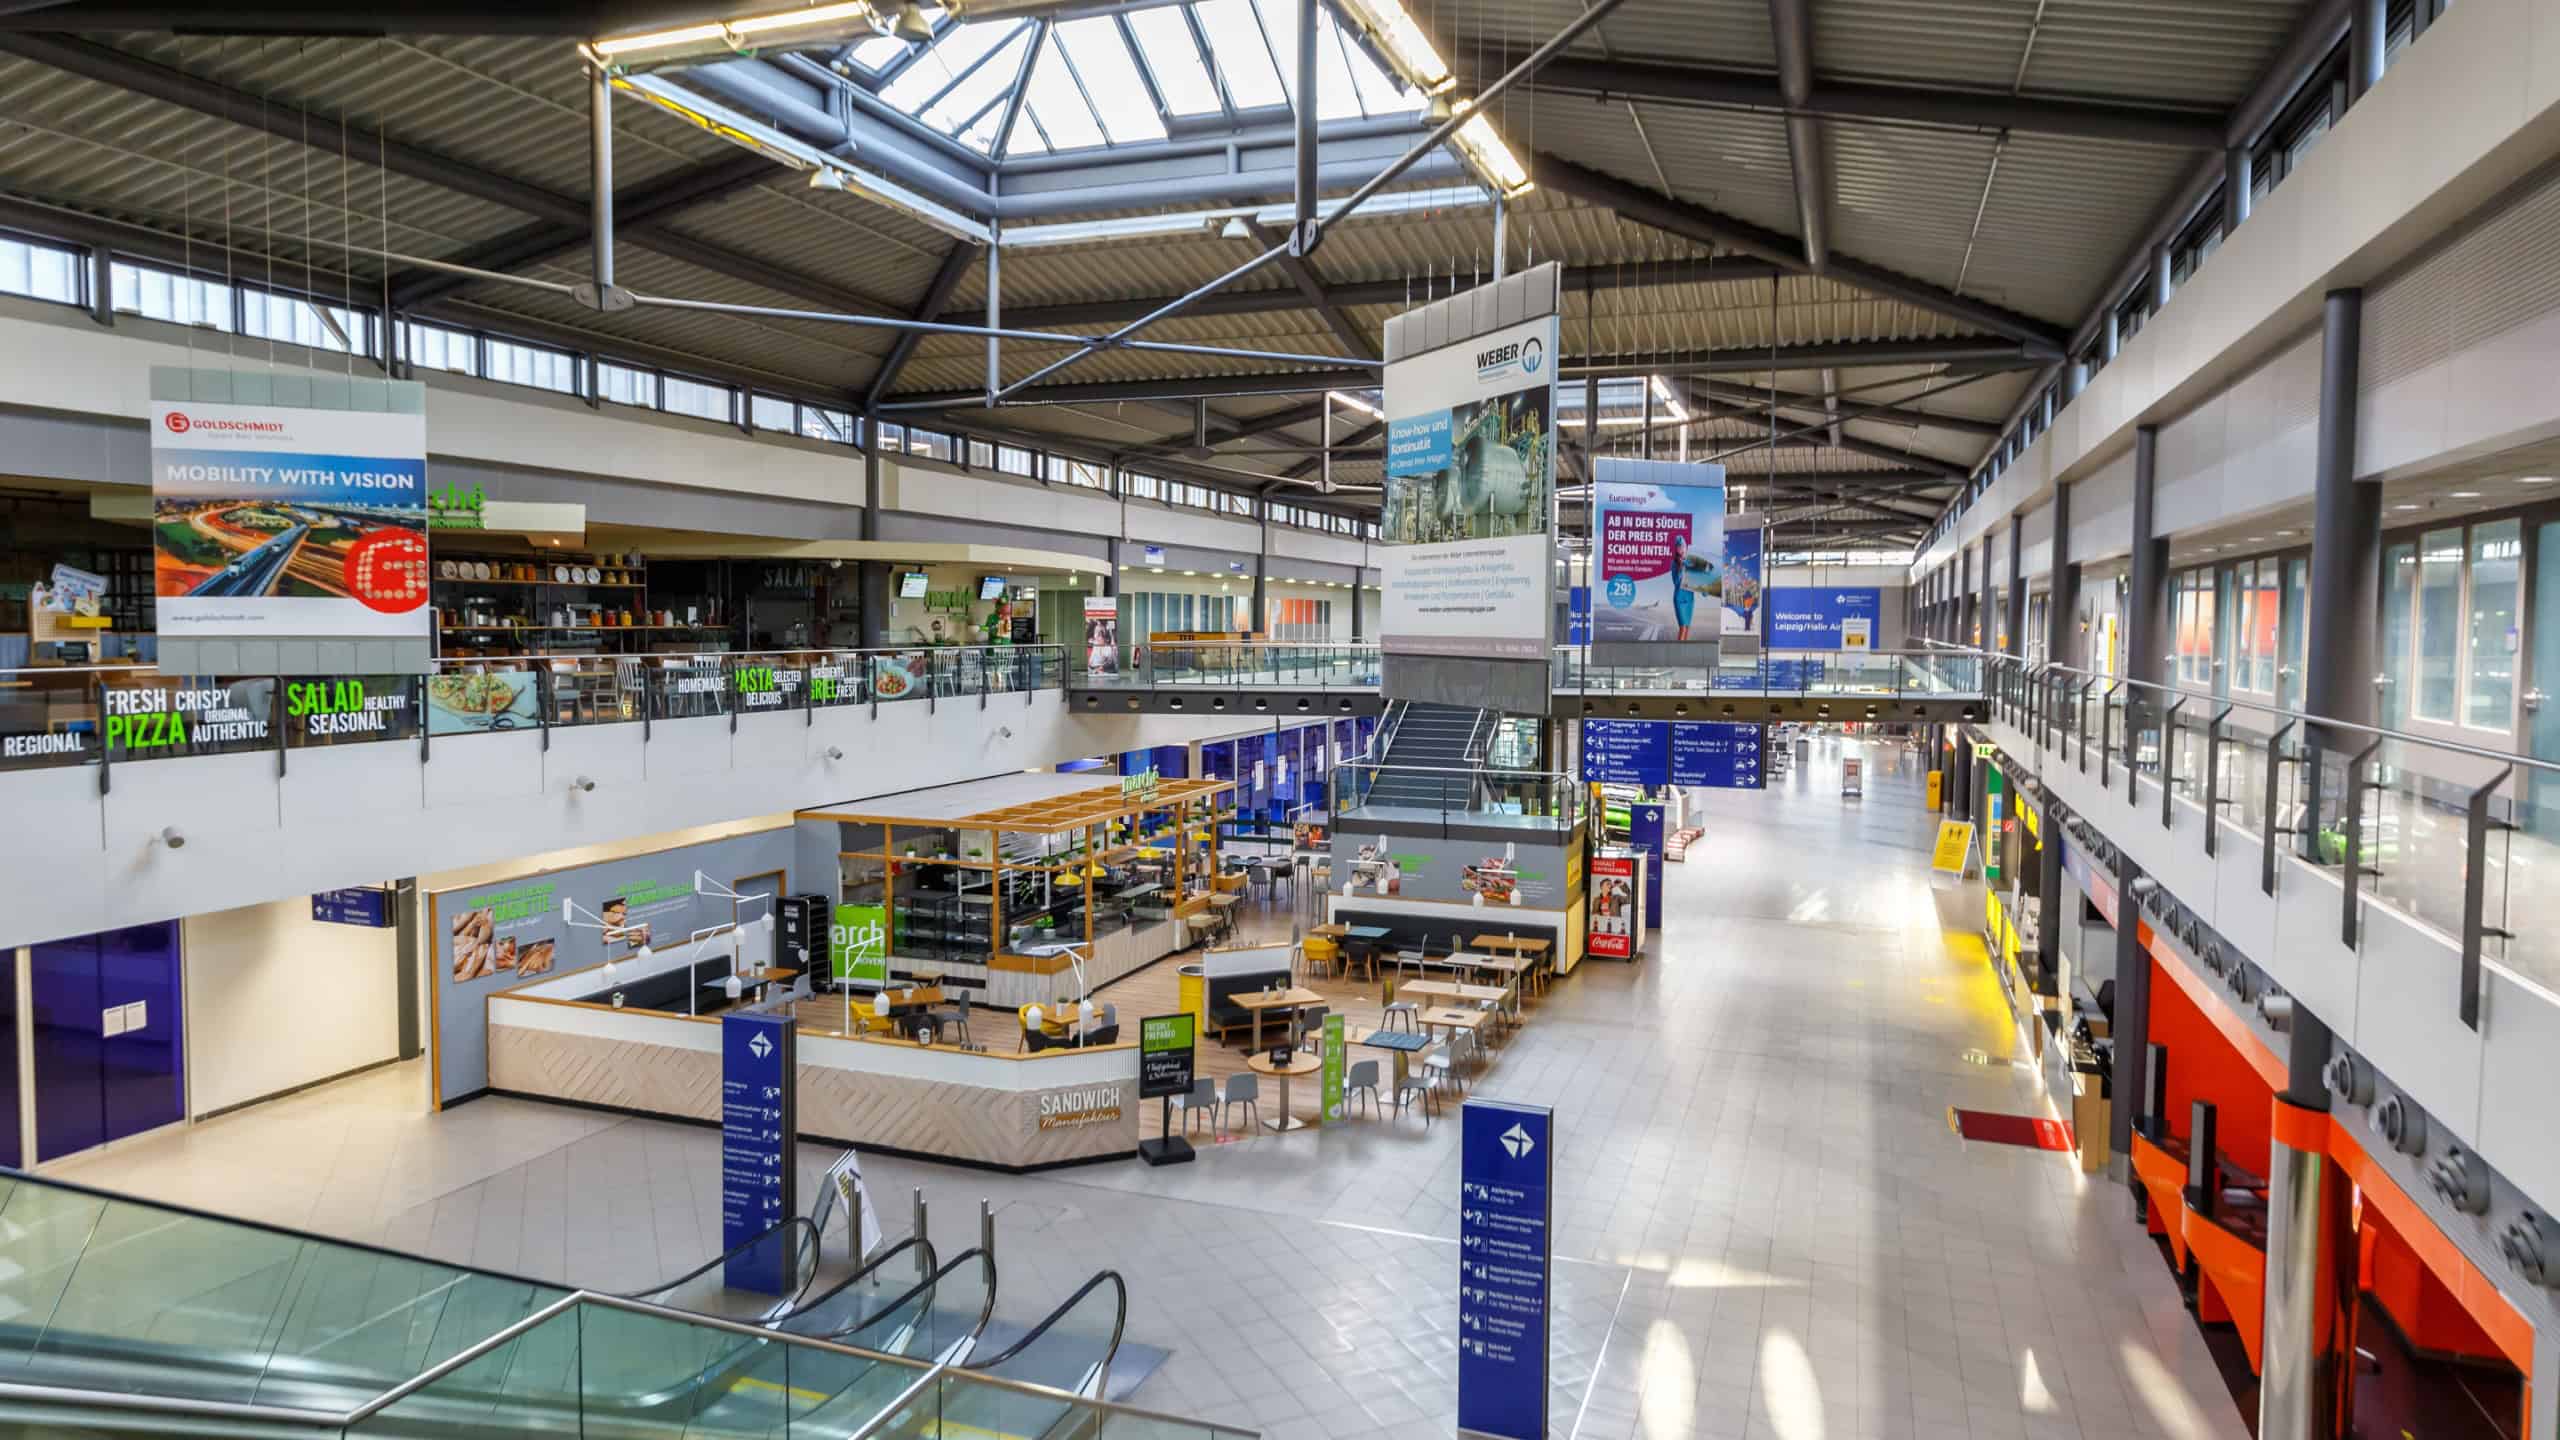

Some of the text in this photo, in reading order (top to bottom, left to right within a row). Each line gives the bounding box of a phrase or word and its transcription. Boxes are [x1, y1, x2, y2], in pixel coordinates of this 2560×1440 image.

[1477, 343, 1520, 369] WEBER
[193, 420, 284, 433] GOLDSCHMIDT
[1432, 416, 1448, 432] und
[167, 465, 415, 489] MOBILITY WITH VISION
[1608, 494, 1647, 505] Eurowings
[1608, 515, 1688, 529] AB IN DEN SÜDEN.
[1608, 530, 1669, 542] DER PREIS IST
[1607, 544, 1673, 557] SCHON UNTEN.
[1775, 612, 1823, 621] Welcome to
[1775, 622, 1828, 632] Leipzig/Halle
[736, 667, 774, 693] PASTA
[773, 671, 802, 683] SELECTED
[677, 677, 726, 694] HOMEMADE
[837, 685, 857, 697] FRESH
[105, 688, 232, 715] FRESH CRISPY
[287, 680, 364, 717] SALAD
[364, 695, 406, 711] HEALTHY
[746, 692, 782, 706] DELICIOUS
[204, 707, 250, 723] ORIGINAL
[308, 711, 386, 735] SEASONAL
[106, 711, 186, 751] PIZZA
[191, 720, 268, 743] AUTHENTIC
[3, 731, 84, 757] REGIONAL
[1040, 1087, 1120, 1115] SANDWICH
[1040, 1110, 1120, 1129] Manufaktur
